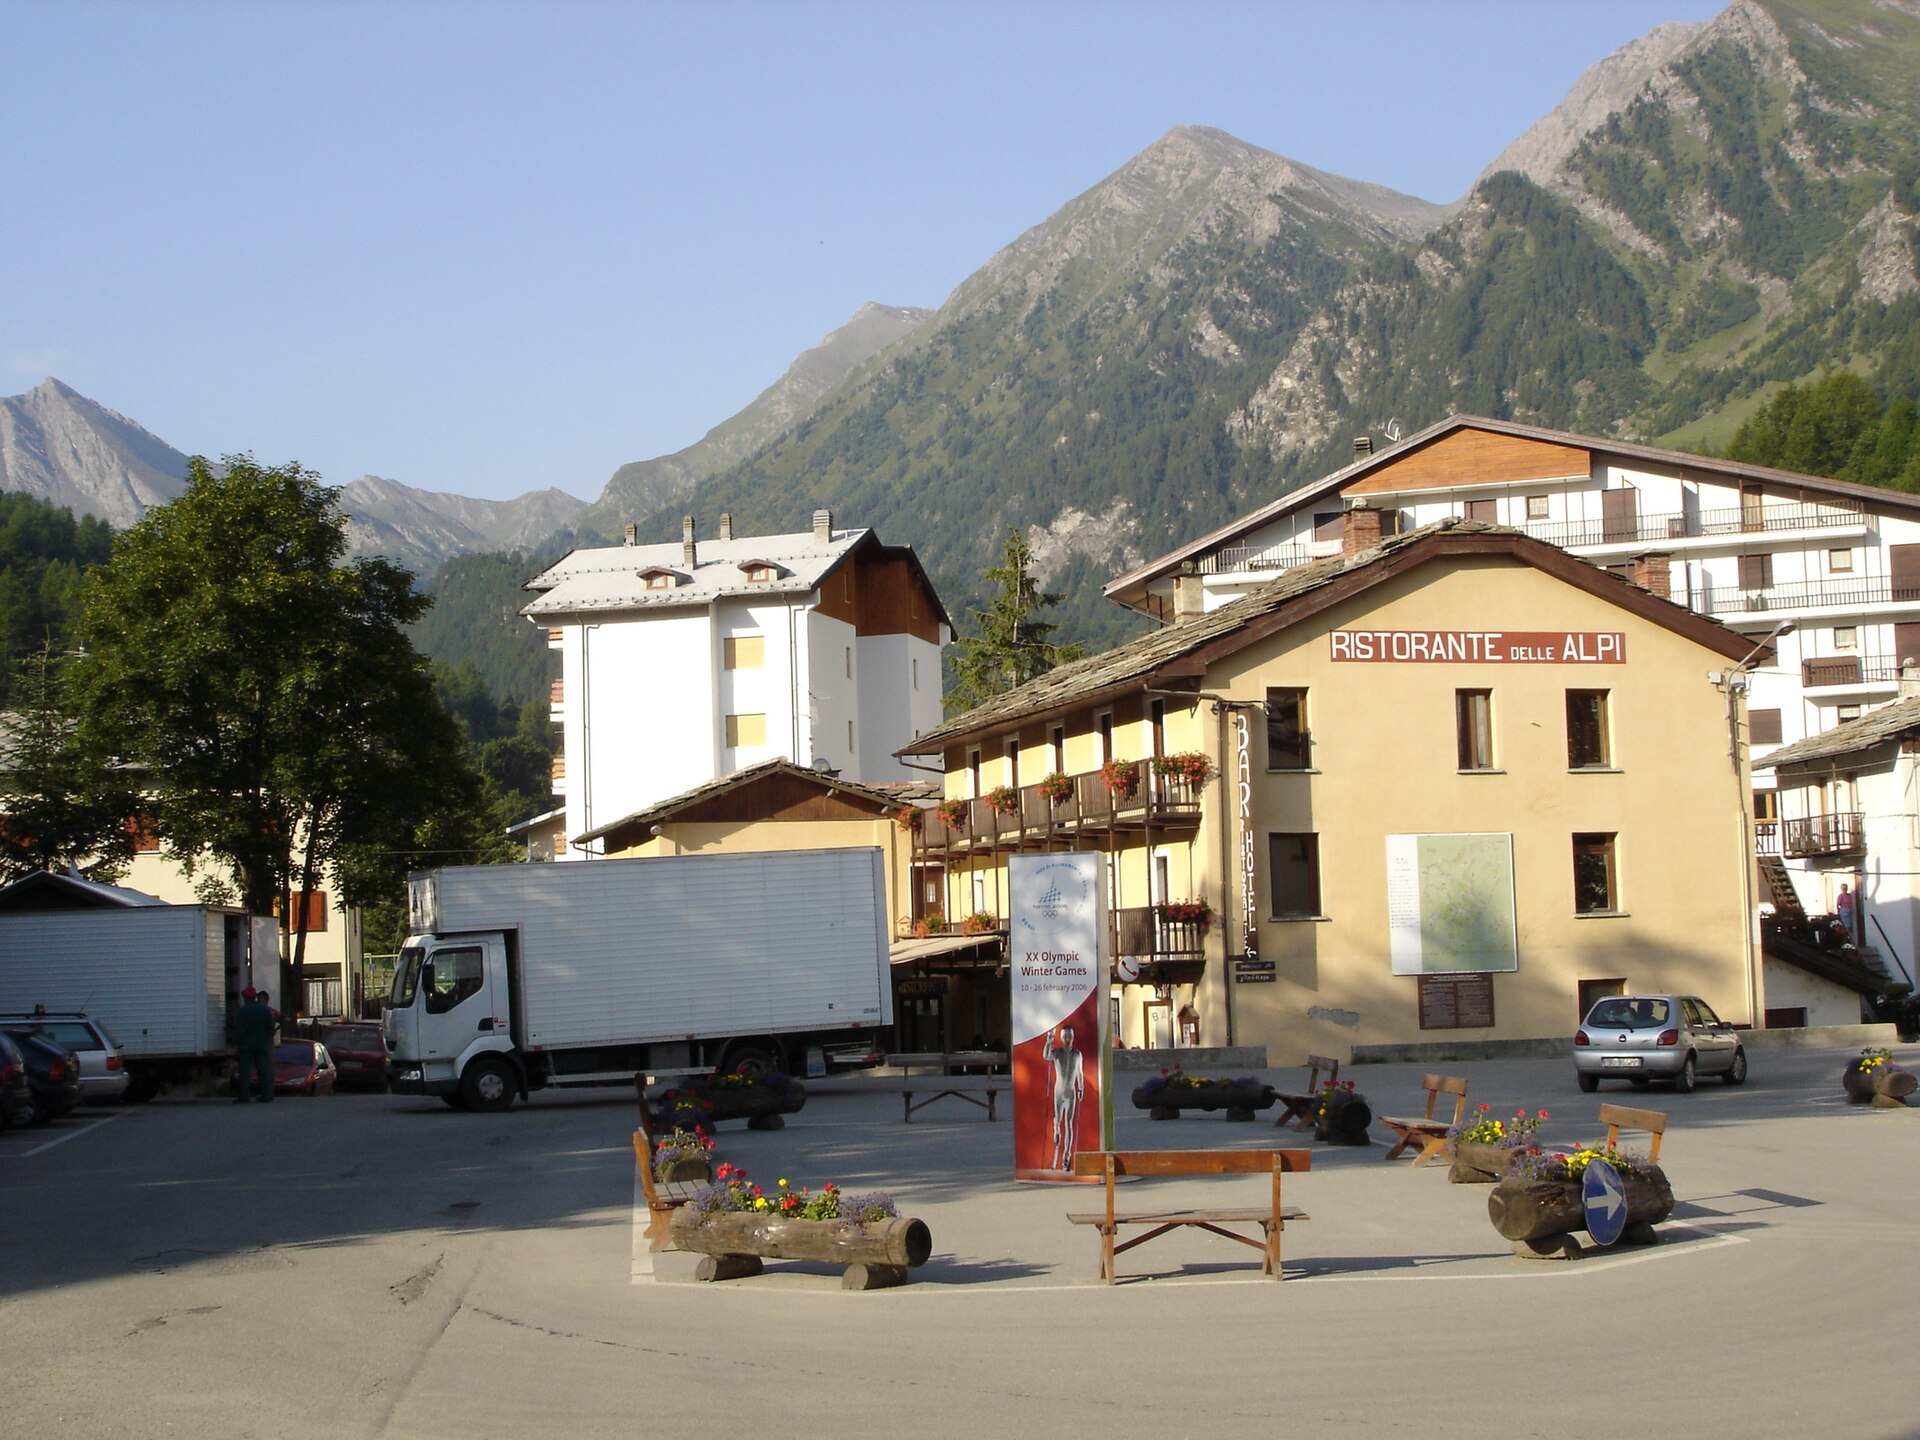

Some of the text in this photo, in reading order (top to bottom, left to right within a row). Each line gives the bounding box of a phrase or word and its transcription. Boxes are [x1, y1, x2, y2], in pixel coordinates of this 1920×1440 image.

[1331, 632, 1621, 661] RISTORANTE DELLE ALPI
[1237, 714, 1251, 818] BAR
[1245, 830, 1257, 932] HOTEL
[1025, 950, 1080, 964] XX Olympic
[1021, 965, 1087, 976] Winter Games
[1021, 984, 1029, 992] 10
[1043, 984, 1070, 993] february
[1071, 983, 1088, 991] 2006
